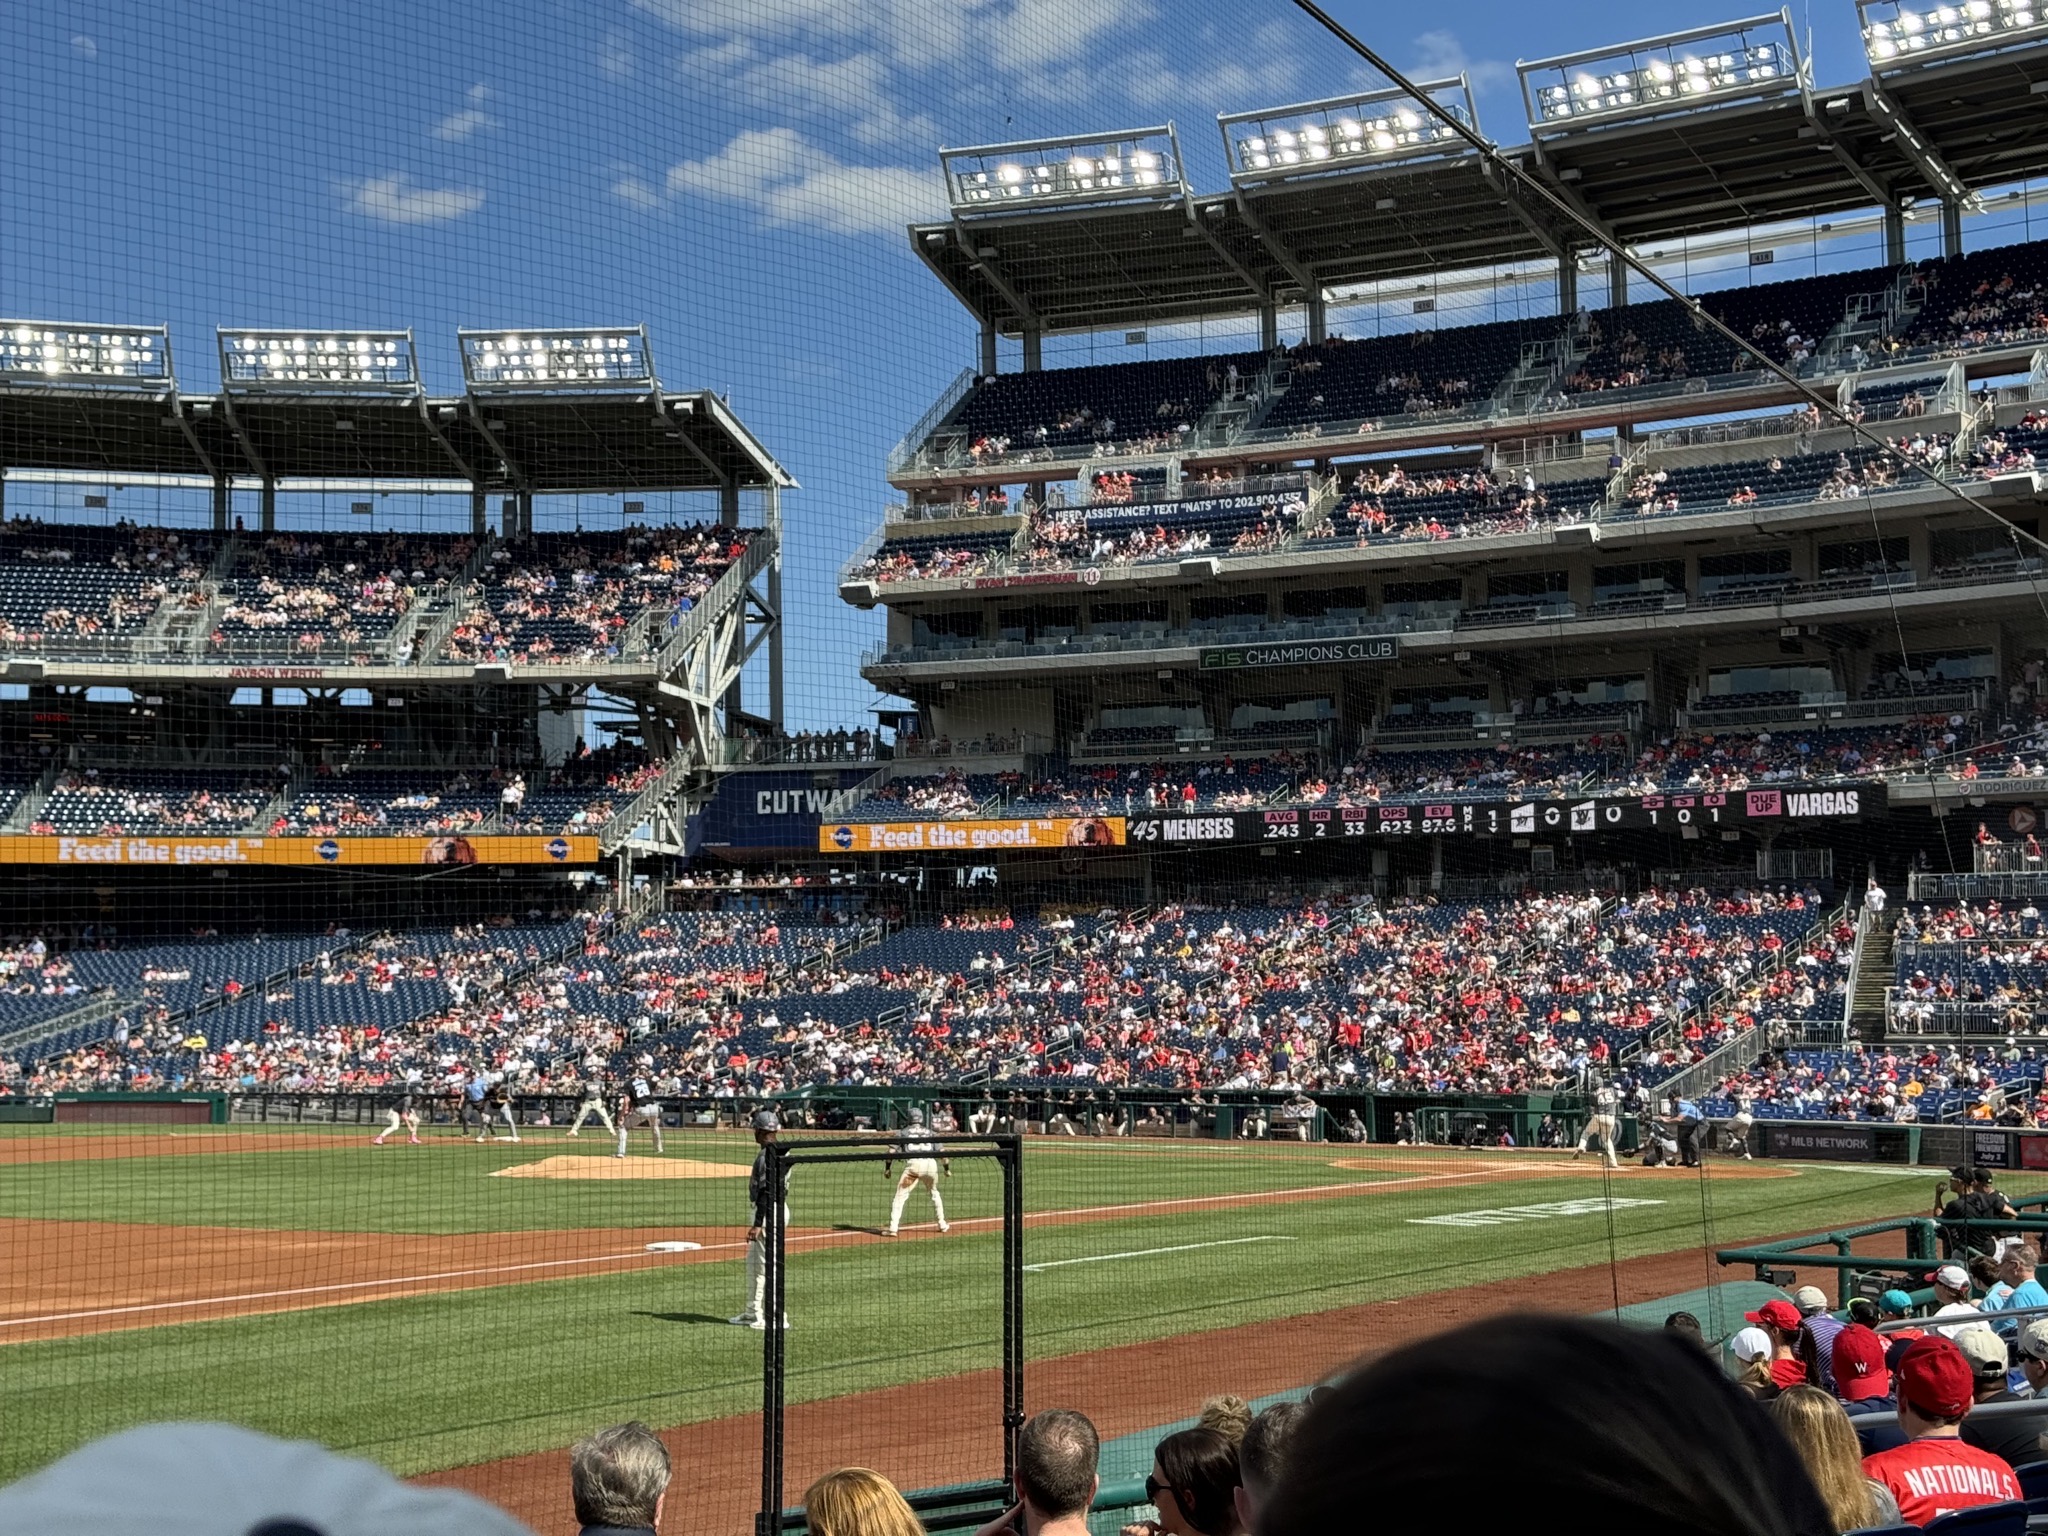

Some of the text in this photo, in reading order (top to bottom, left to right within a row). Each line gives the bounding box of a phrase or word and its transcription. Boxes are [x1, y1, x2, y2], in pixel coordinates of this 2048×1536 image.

[1085, 506, 1150, 519] ASSISTANCE?
[1152, 504, 1178, 515] TEXT
[1219, 499, 1232, 509] TO
[1246, 646, 1343, 664] CHAMPIONS
[1348, 643, 1392, 658] CLUB
[229, 668, 322, 678] JAYSON WERTH
[1976, 781, 2046, 792] RODRIGUEZ
[1751, 794, 1777, 804] DUE
[1787, 791, 1859, 817] VARGAS
[1382, 808, 1405, 817] OPS
[1432, 807, 1446, 815] EV
[1756, 803, 1772, 812] UP
[1269, 813, 1293, 821] AVG
[1649, 811, 1657, 824] 1
[1678, 809, 1691, 823] 0
[1711, 808, 1718, 822] 1
[1163, 818, 1233, 840] MENESES
[1264, 824, 1299, 838] .243
[1315, 823, 1325, 836] 2
[1345, 822, 1364, 835] 33
[1376, 820, 1412, 833] .623
[871, 825, 923, 848] Feed
[928, 825, 966, 846] the
[58, 838, 121, 861] Feed
[127, 838, 169, 860] the
[1791, 1137, 1813, 1146] MLB
[1816, 1137, 1868, 1149] NETWORK
[1976, 1133, 2005, 1143] FREEDOM
[1855, 1363, 1867, 1373] W
[1904, 1465, 2014, 1501] NATIONALS
